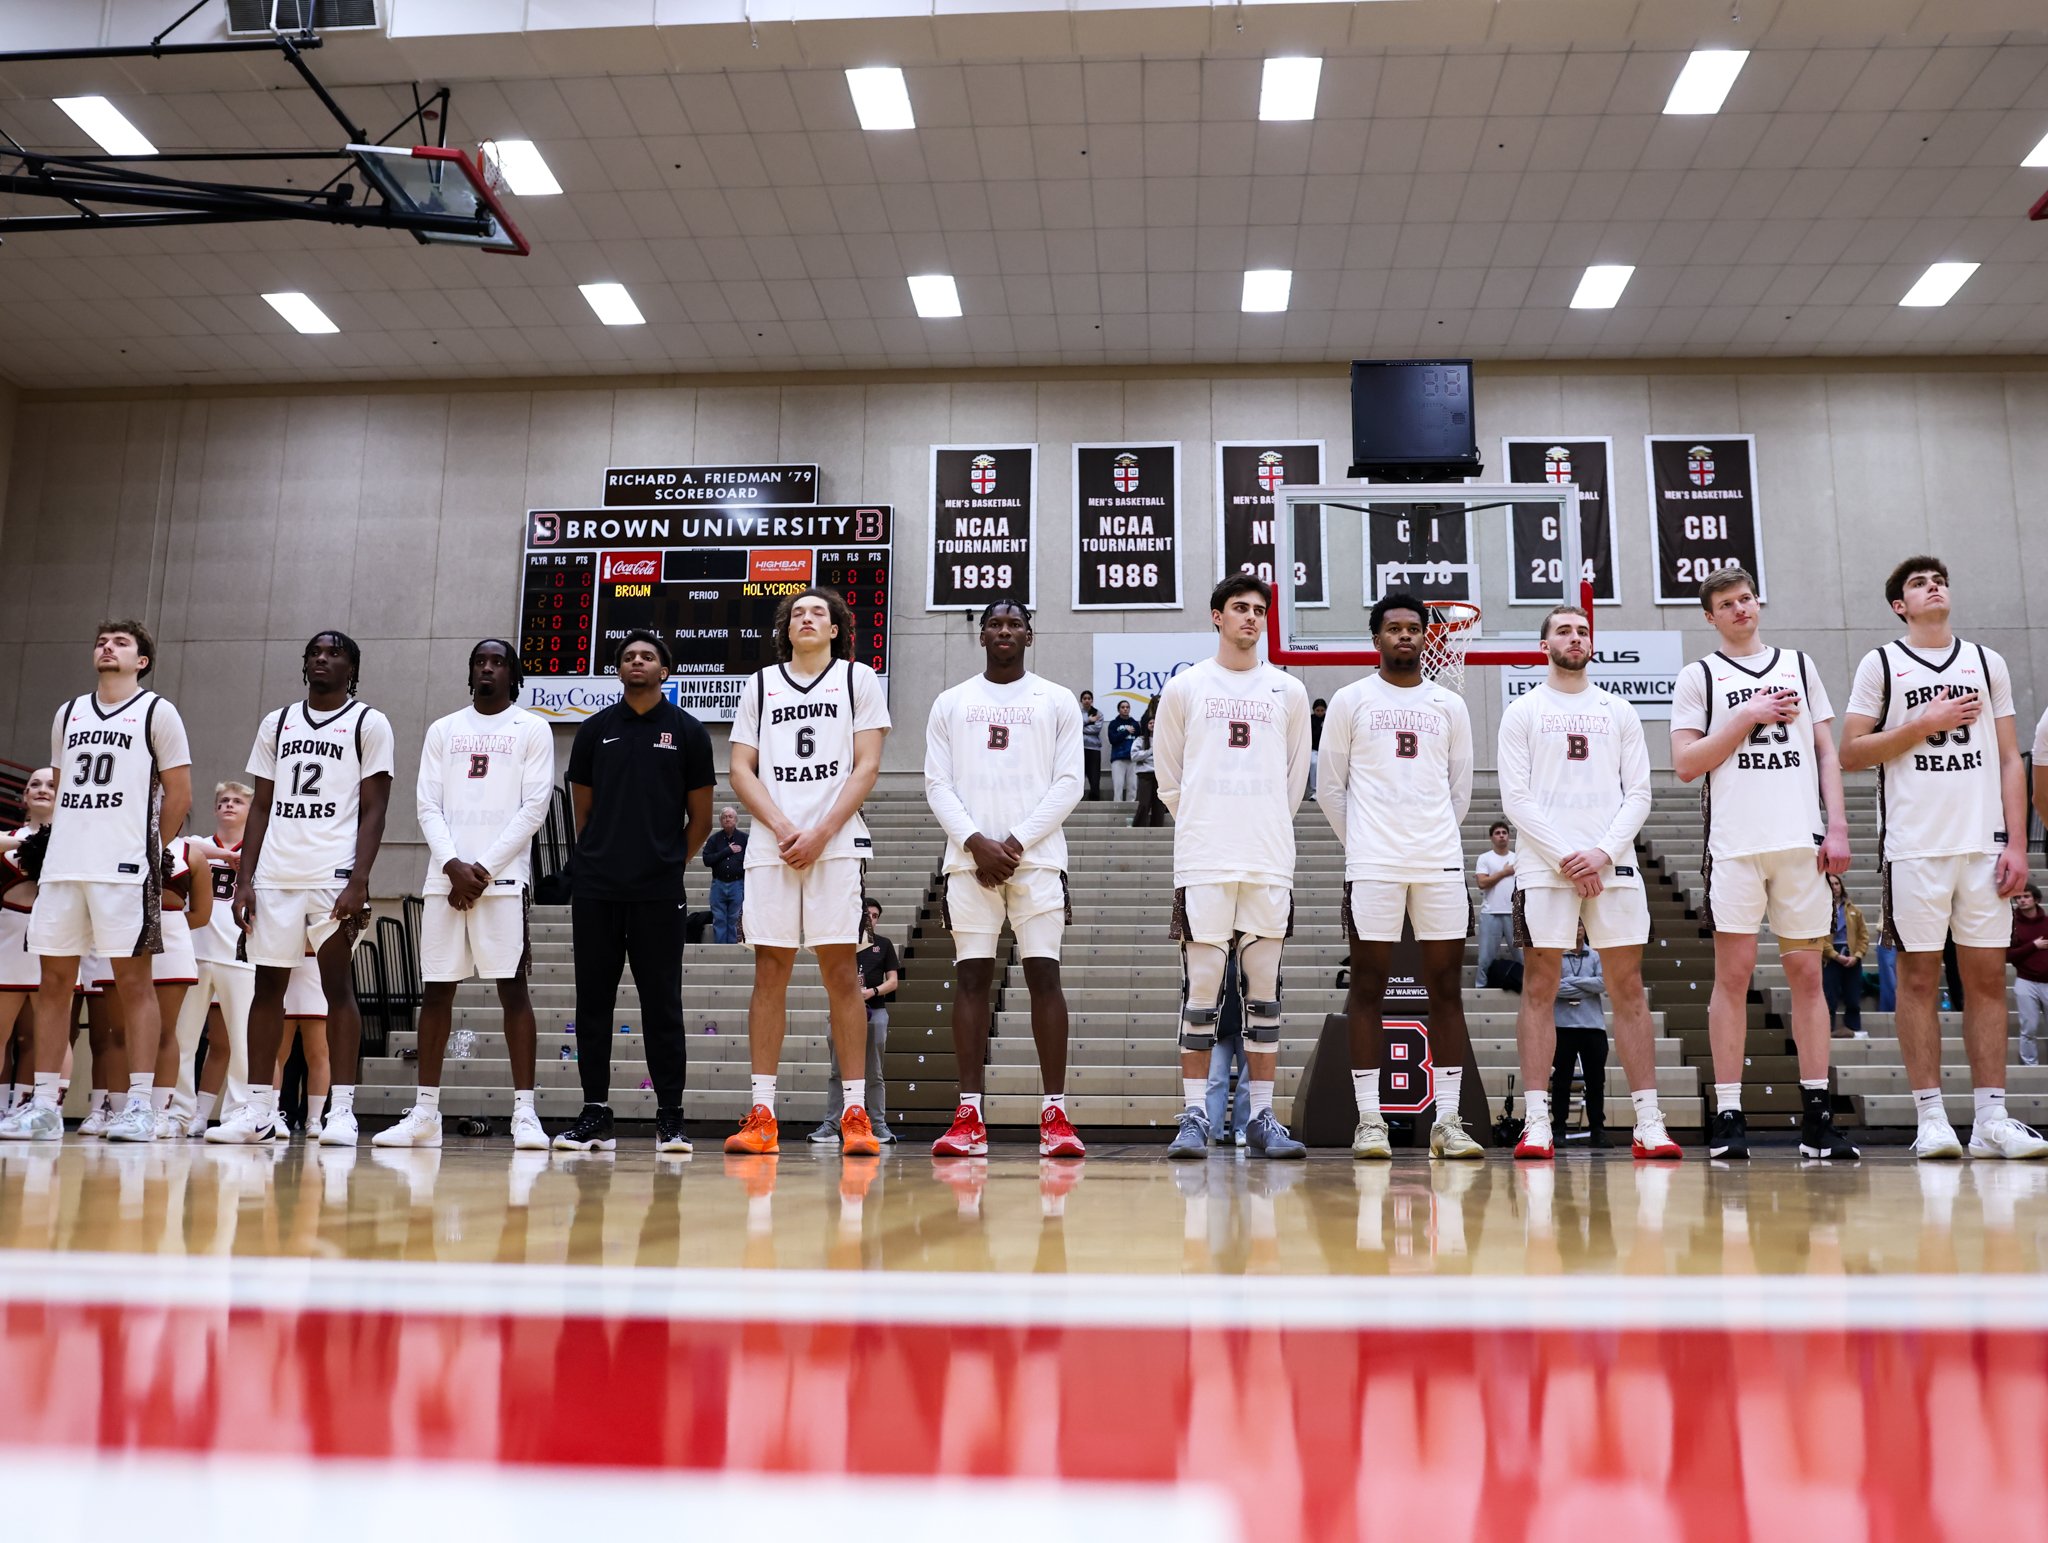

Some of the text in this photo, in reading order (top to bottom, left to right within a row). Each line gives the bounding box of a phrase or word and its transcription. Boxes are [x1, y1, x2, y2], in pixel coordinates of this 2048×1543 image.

[609, 471, 812, 486] RICHARD A. FRIEDMAN '79
[654, 487, 758, 500] SCOREBOARD
[1233, 495, 1258, 505] MEN'S
[1664, 489, 1744, 499] MEN'S BASKETBALL
[945, 499, 1022, 508] MEN'S BASKETBALL
[1088, 497, 1165, 506] MEN'S BASKETBALL
[566, 519, 670, 539] BROWN
[682, 516, 850, 538] UNIVERSITY
[855, 509, 883, 541] B
[955, 517, 1010, 538] NCAA
[1099, 515, 1155, 536] NCAA
[1397, 518, 1439, 543] CI
[1684, 515, 1728, 540] CBI
[937, 539, 1028, 554] TOURNAMENT
[1081, 537, 1173, 552] TOURNAMENT
[530, 555, 588, 565] PLYR FLS PTS
[755, 560, 806, 568] HIGHBAR
[822, 552, 882, 562] PLYR FLS PTS
[612, 560, 657, 576] Coca-Cola
[1096, 563, 1159, 588] 1986
[1240, 562, 1307, 586] 203
[1531, 558, 1596, 583] 204
[555, 572, 564, 587] 0
[581, 572, 591, 587] 0
[848, 569, 857, 584] 0
[875, 569, 885, 583] 0
[951, 564, 1013, 589] 1939
[615, 584, 651, 598] BROWN
[689, 590, 719, 600] PERIOD
[743, 583, 807, 596] HOLYCROSS
[554, 593, 563, 608] 0
[580, 593, 589, 608] 0
[874, 590, 884, 605] 0
[552, 615, 561, 629] 0
[579, 614, 588, 629] 0
[873, 612, 883, 627] 0
[675, 629, 729, 638] FOUL PLAYER
[740, 629, 762, 638] T.O.L.
[873, 633, 883, 649] 0
[524, 635, 587, 651] 23 0 0
[1289, 644, 1319, 652] SPALDING
[523, 658, 543, 672] 45
[549, 657, 559, 673] 0
[576, 657, 586, 673] 0
[676, 663, 725, 673] ADVANTAGE
[681, 680, 747, 694] UNIVERSIT
[531, 687, 625, 712] BayCoast
[771, 703, 838, 725] BROWN
[966, 705, 1035, 725] FAMILY
[1205, 698, 1275, 723] FAMILY
[1370, 709, 1441, 735] FAMILY
[1541, 714, 1610, 735] FAMILY
[67, 730, 133, 750] BROWN
[660, 732, 673, 745] B
[795, 725, 816, 759] 6
[987, 724, 1010, 751] B
[1228, 720, 1251, 749] B
[280, 740, 344, 760] BROWN
[450, 734, 517, 755] FAMILY
[1395, 730, 1418, 759] B
[1566, 733, 1589, 761] B
[72, 751, 116, 787] 30
[468, 753, 490, 779] B
[774, 760, 839, 783] BEARS
[291, 761, 324, 797] 12
[60, 792, 124, 809] BEARS
[275, 801, 337, 819] BEARS
[210, 864, 238, 902] B
[943, 981, 950, 989] 6
[1388, 976, 1415, 984] XUS
[1385, 988, 1395, 996] OF
[936, 1004, 942, 1012] 5
[918, 1055, 925, 1063] 3
[1744, 1058, 1752, 1066] 3
[908, 1083, 916, 1091] 2
[1765, 1086, 1773, 1095] 2
[898, 1113, 904, 1121] 1
[1789, 1116, 1796, 1125] 1
